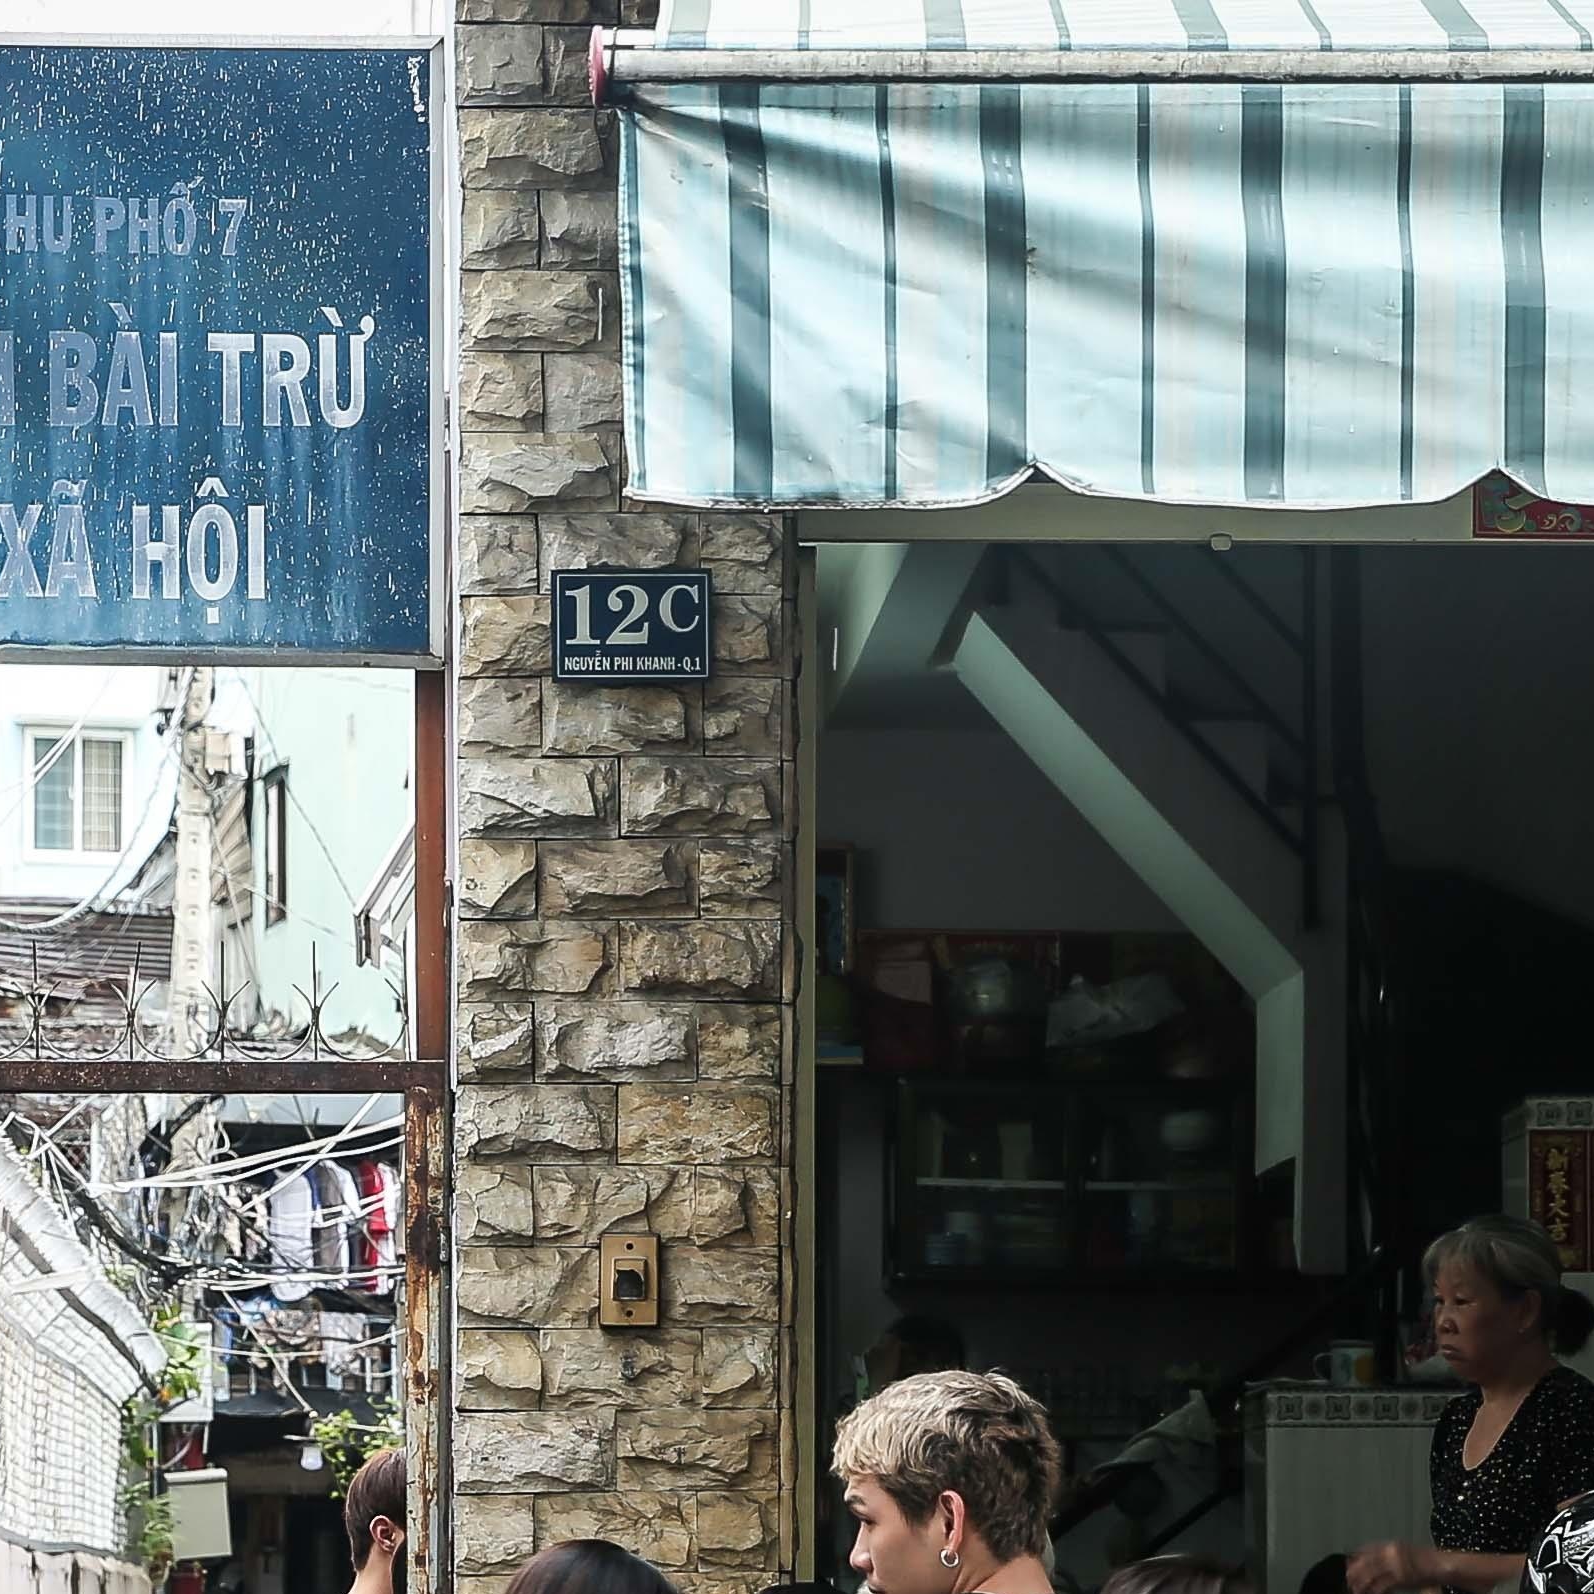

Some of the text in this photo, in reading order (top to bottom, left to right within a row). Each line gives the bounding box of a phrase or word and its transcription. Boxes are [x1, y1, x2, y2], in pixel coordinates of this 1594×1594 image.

[93, 174, 197, 256] PHỐ
[218, 197, 248, 257] 7
[47, 302, 179, 428] BÀI
[206, 308, 375, 429] TRỪ
[132, 477, 267, 624] HỘI
[565, 584, 699, 645] 12C
[614, 656, 633, 671] PHI
[636, 656, 675, 671] KHANH
[682, 656, 701, 673] Q.1
